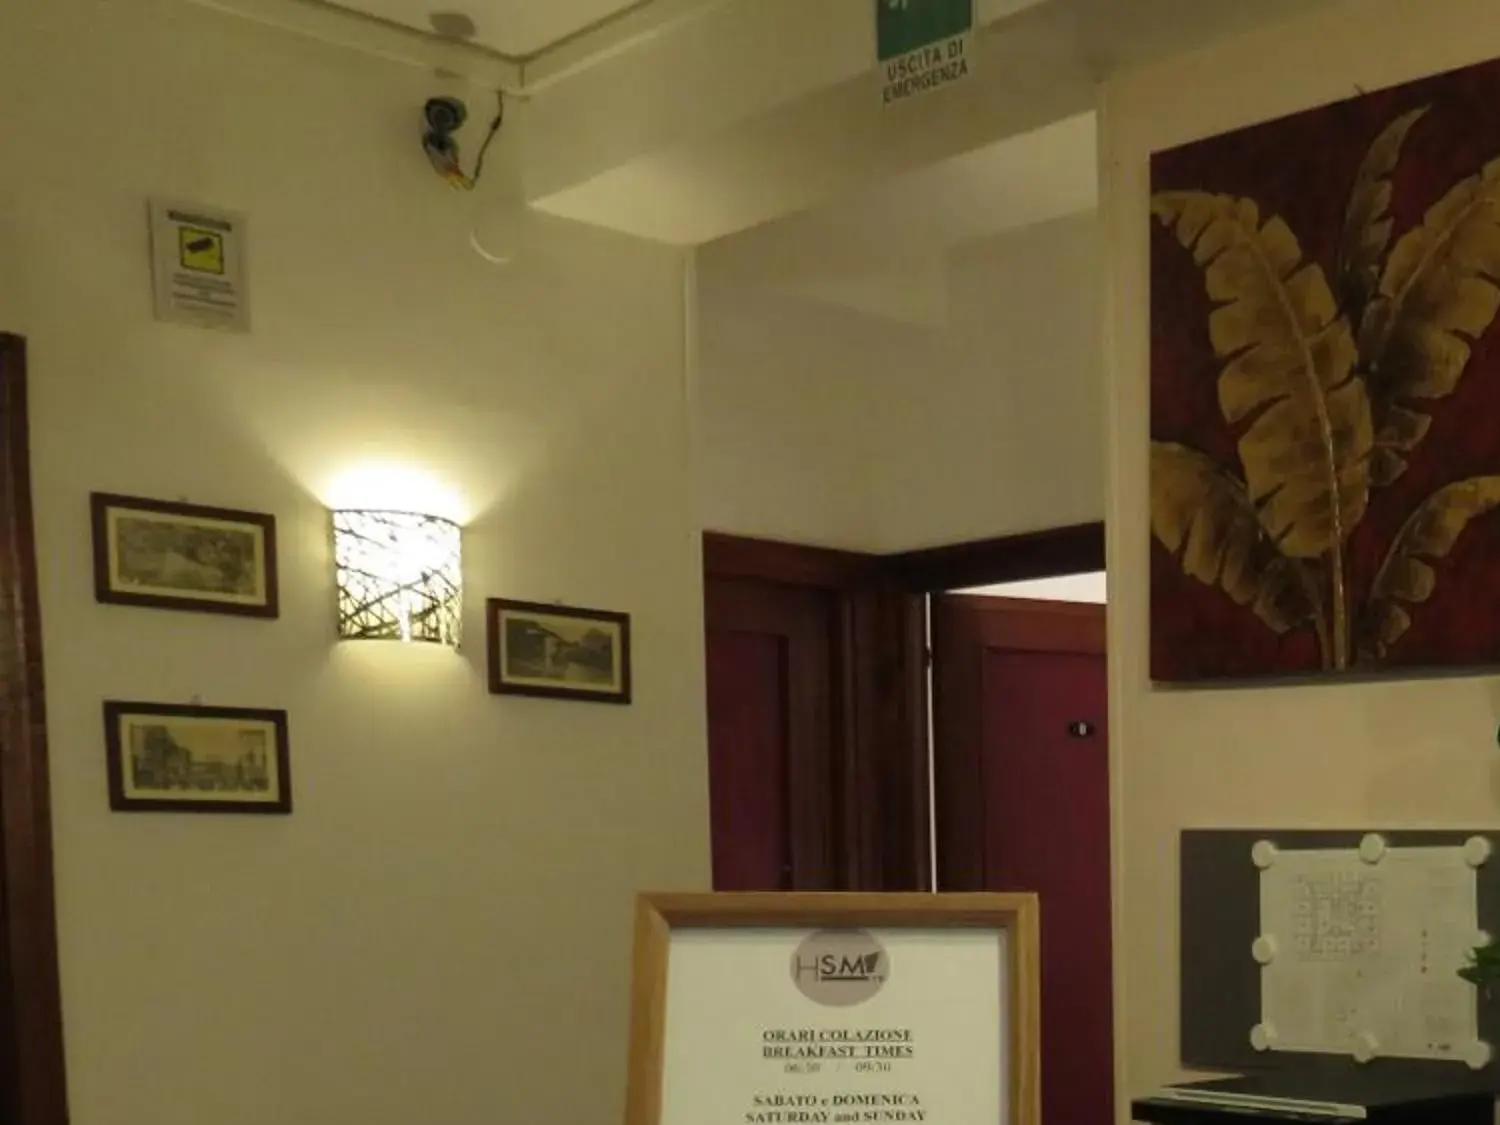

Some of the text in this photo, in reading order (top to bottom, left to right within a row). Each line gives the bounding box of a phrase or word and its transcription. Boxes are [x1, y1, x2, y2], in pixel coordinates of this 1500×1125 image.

[887, 38, 964, 82] USCITA DI
[882, 58, 969, 103] EMERGENZA
[762, 1028, 914, 1043] ORARI COLAZIONE
[762, 1044, 914, 1059] BREAKFAST TIMES
[753, 1094, 817, 1108] SABATO
[832, 1093, 921, 1107] DOMENICA
[744, 1109, 927, 1125] SATURDAY and SUNDAY
